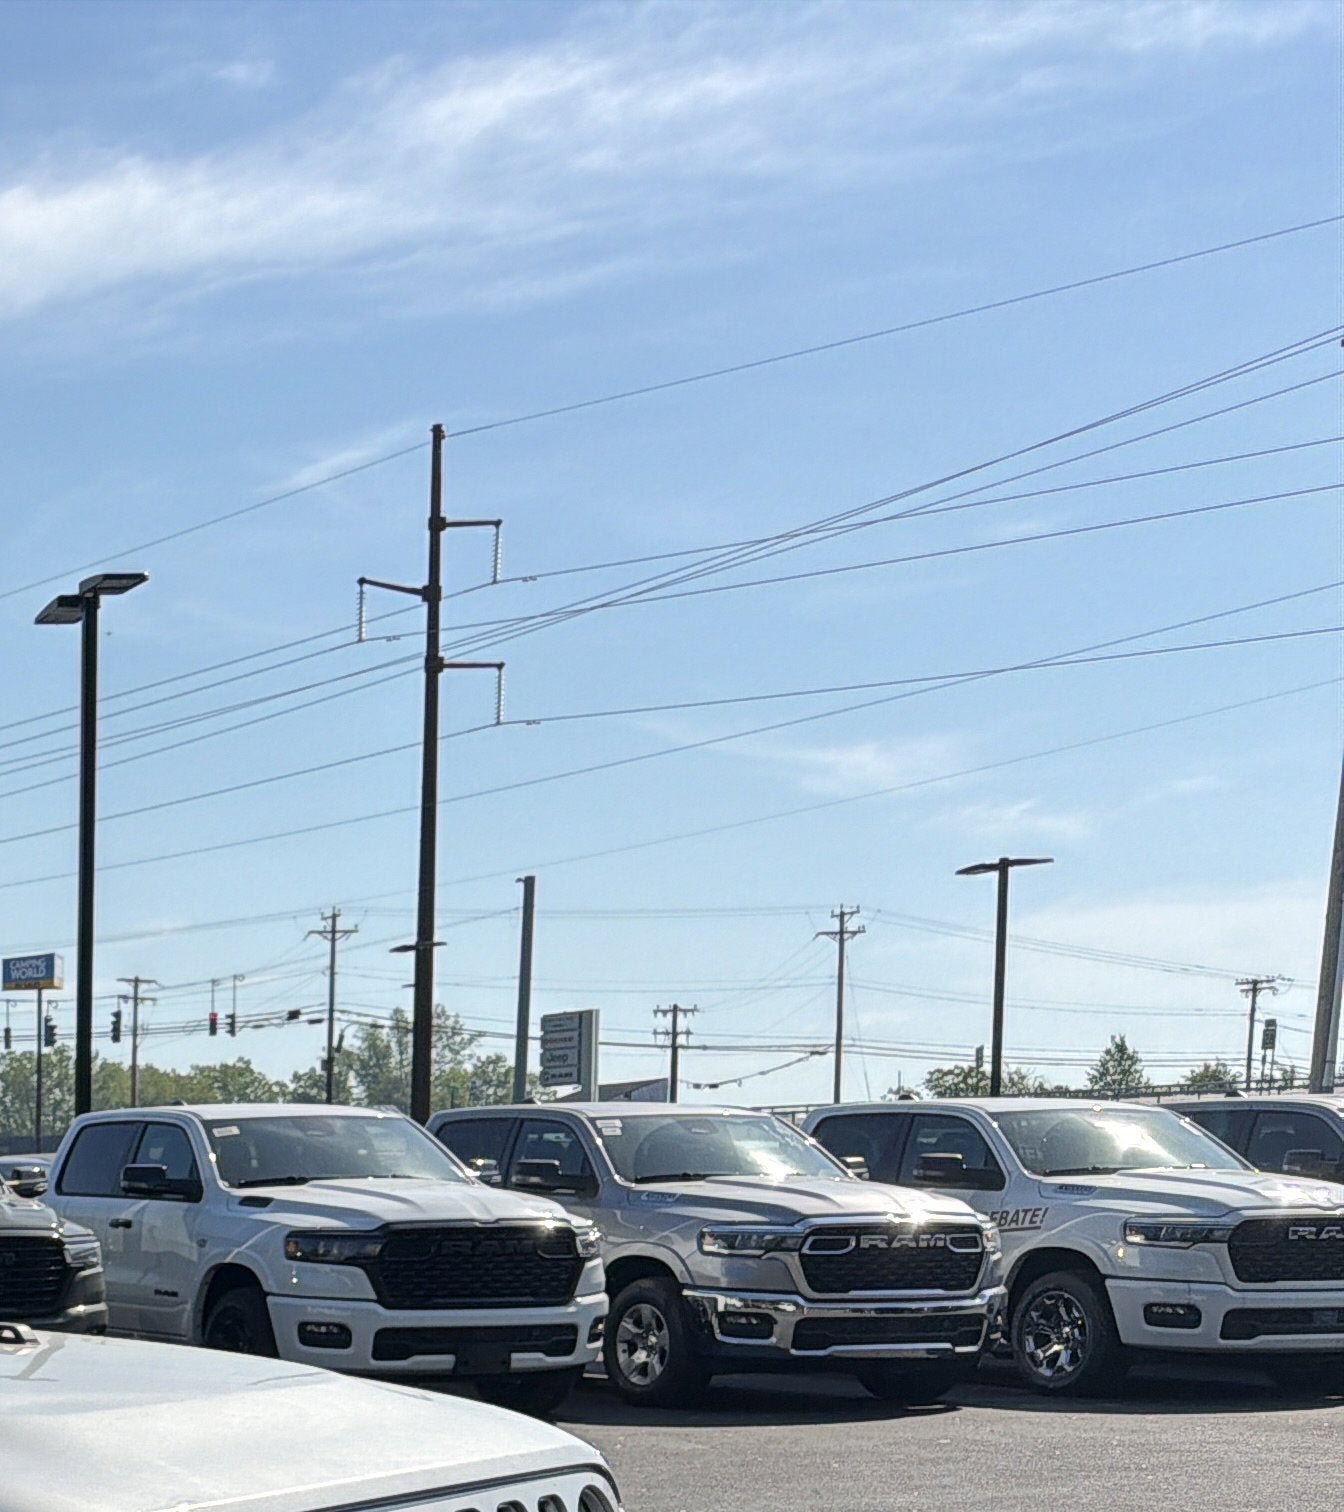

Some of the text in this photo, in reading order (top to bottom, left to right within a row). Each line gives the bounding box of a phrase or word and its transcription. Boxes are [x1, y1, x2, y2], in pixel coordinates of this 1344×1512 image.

[11, 967, 46, 979] WORLD
[989, 1207, 1049, 1227] EBATE!
[860, 1234, 945, 1248] RAM
